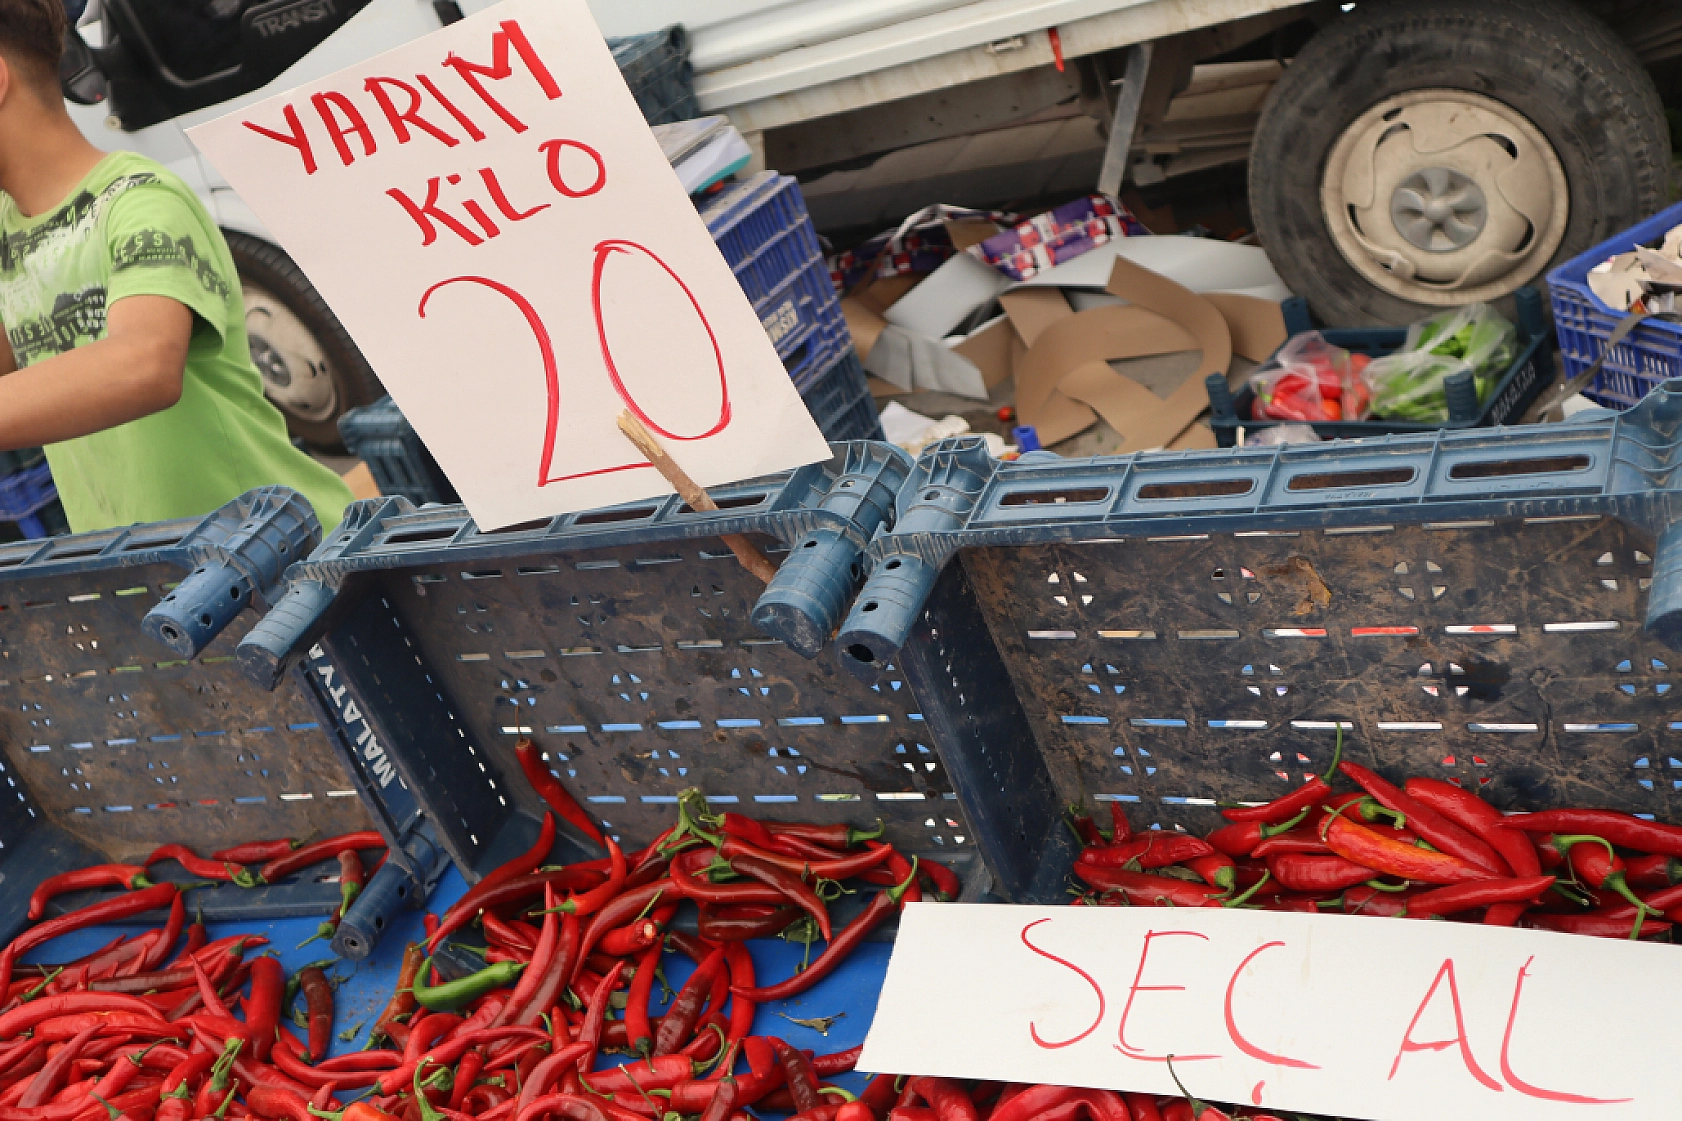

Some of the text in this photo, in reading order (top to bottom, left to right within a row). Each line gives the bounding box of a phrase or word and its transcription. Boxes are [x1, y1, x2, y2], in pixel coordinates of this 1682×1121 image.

[241, 19, 563, 175] YARIM
[418, 239, 732, 487] 20
[1020, 917, 1634, 1106] SEÇ AL
